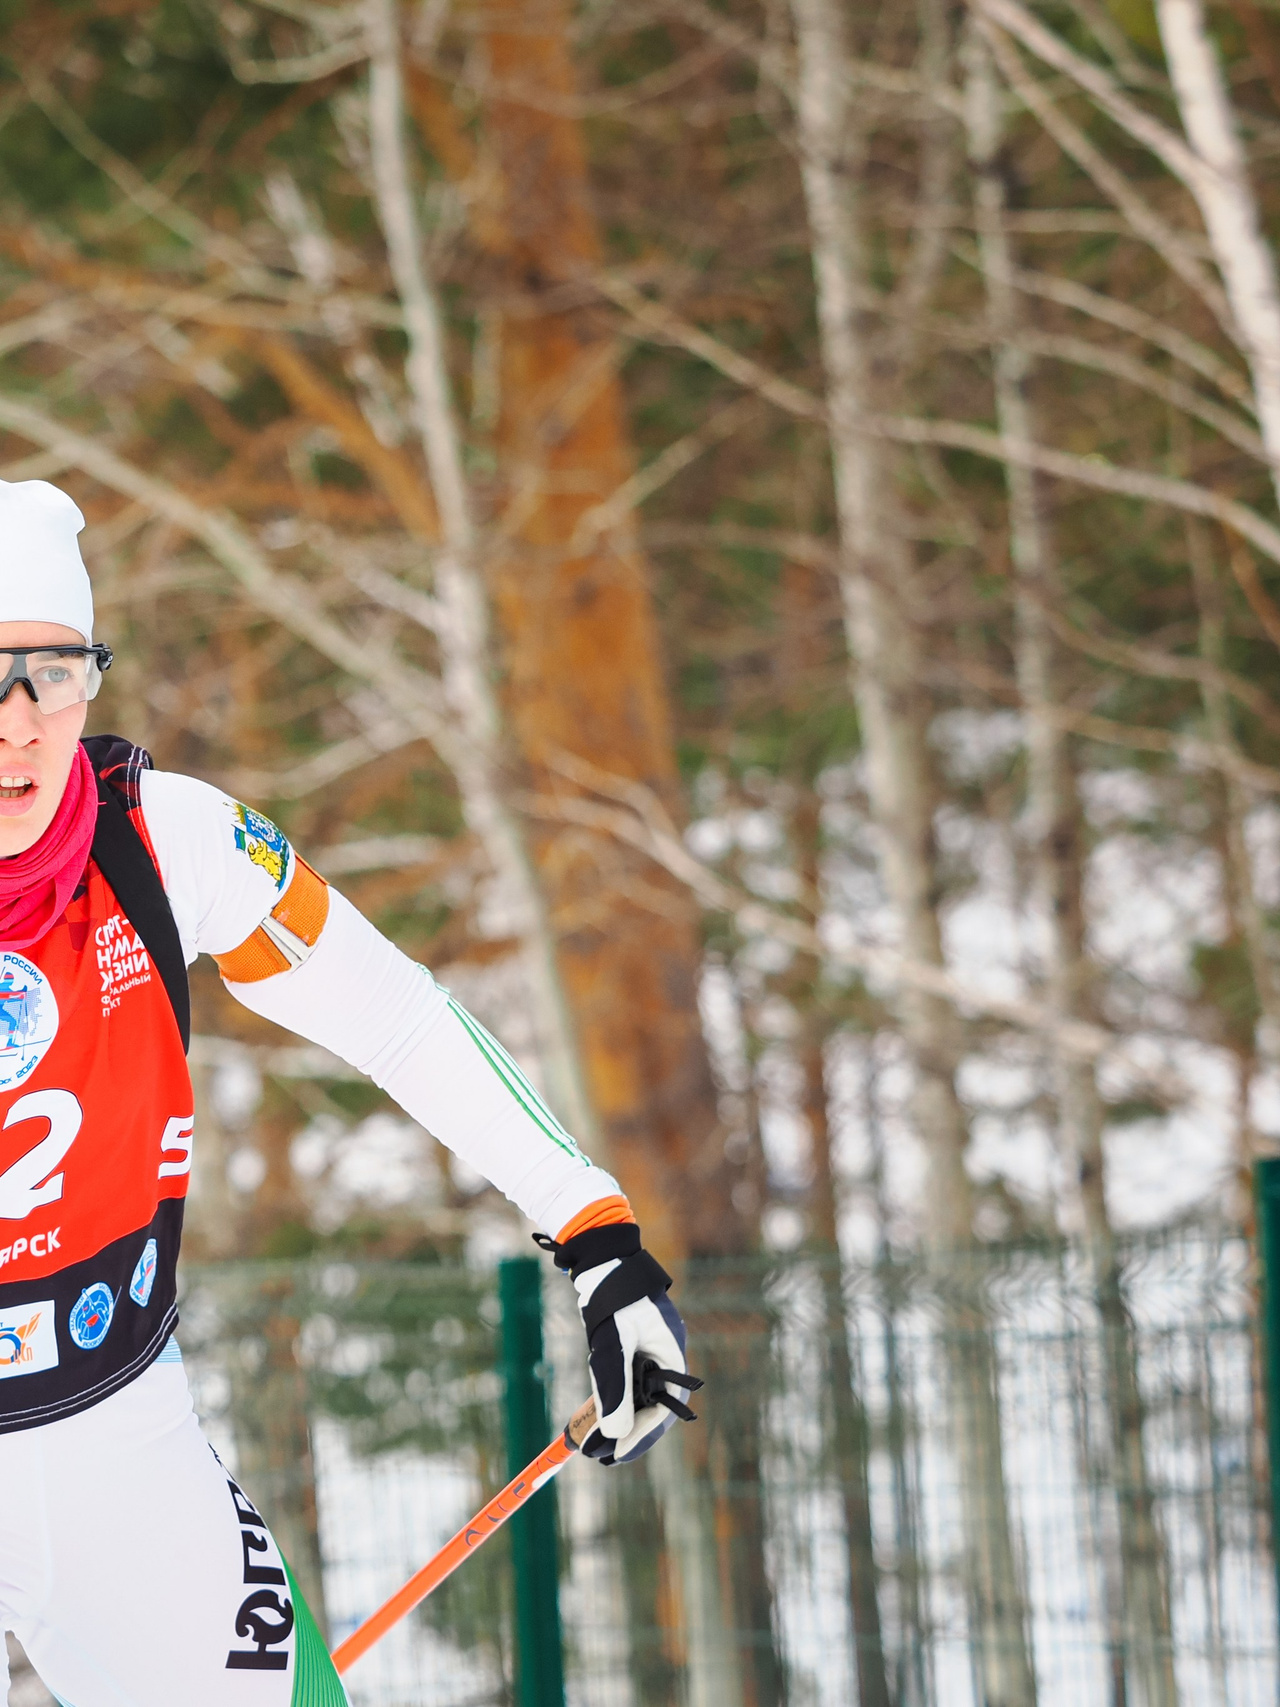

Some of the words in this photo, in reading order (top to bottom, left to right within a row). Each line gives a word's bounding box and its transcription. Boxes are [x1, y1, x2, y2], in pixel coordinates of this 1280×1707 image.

[95, 914, 130, 946] СПРТ-
[3, 954, 43, 985] РОССИИ
[16, 1055, 39, 1079] 2023
[208, 1443, 295, 1672] ЮГР
